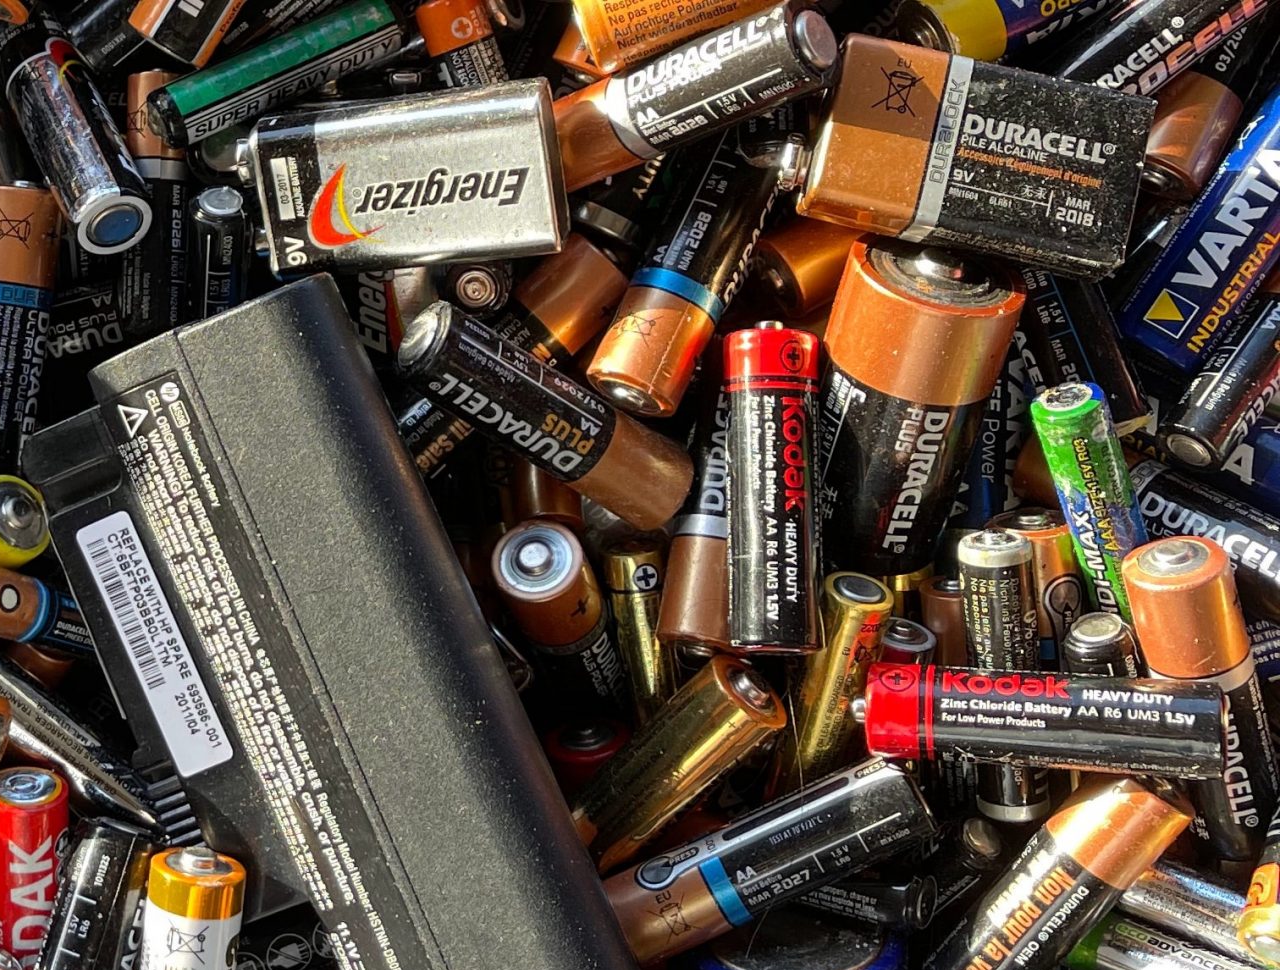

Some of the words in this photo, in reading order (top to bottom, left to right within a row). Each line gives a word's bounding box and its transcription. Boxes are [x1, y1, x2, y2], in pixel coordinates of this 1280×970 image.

[617, 31, 646, 49] Nicht
[194, 103, 260, 138] SUPER
[267, 64, 333, 107] HEAVY
[338, 37, 394, 76] DUTY
[627, 76, 668, 103] PLUS
[665, 55, 725, 91] POWER
[635, 106, 660, 127] AA
[957, 147, 1006, 166] Accessoire
[960, 135, 991, 154] PILE
[990, 142, 1050, 163] ALCALINE
[685, 211, 713, 249] 2028
[1055, 206, 1095, 229] 2018
[284, 235, 307, 267] 9V
[1186, 230, 1280, 355] INDUSTRIAL
[540, 412, 596, 455] PLUS
[577, 418, 601, 437] AA
[764, 424, 776, 468] Chloride
[893, 405, 923, 453] PLUS
[178, 426, 208, 474] Notebook
[197, 472, 223, 509] Battery
[781, 394, 807, 513] Kodak
[145, 428, 185, 498] WARNING!
[181, 512, 209, 556] reduce
[764, 469, 778, 514] Battery
[154, 414, 180, 453] ORIGIN
[169, 450, 195, 487] KOREA
[183, 486, 215, 536] FURTHER
[203, 533, 242, 600] PROCESSED
[236, 608, 261, 646] CHINA
[163, 503, 194, 554] external
[114, 526, 153, 585] REPLACE
[141, 584, 166, 618] WITH
[163, 635, 194, 680] SPARE
[785, 566, 799, 604] DUTY
[941, 672, 1069, 698] Kodak
[1082, 688, 1131, 702] HEAVY
[1133, 692, 1173, 705] DUTY
[969, 700, 1022, 712] Chloride
[1024, 702, 1071, 717] Battery
[171, 691, 203, 736] 2011/04
[312, 791, 347, 845] Regulatory
[736, 866, 758, 882] AA
[772, 869, 811, 895] 2027
[1032, 864, 1077, 911] Non
[997, 897, 1043, 947] pour
[981, 936, 1013, 967] la
[1015, 941, 1040, 966] OEM
